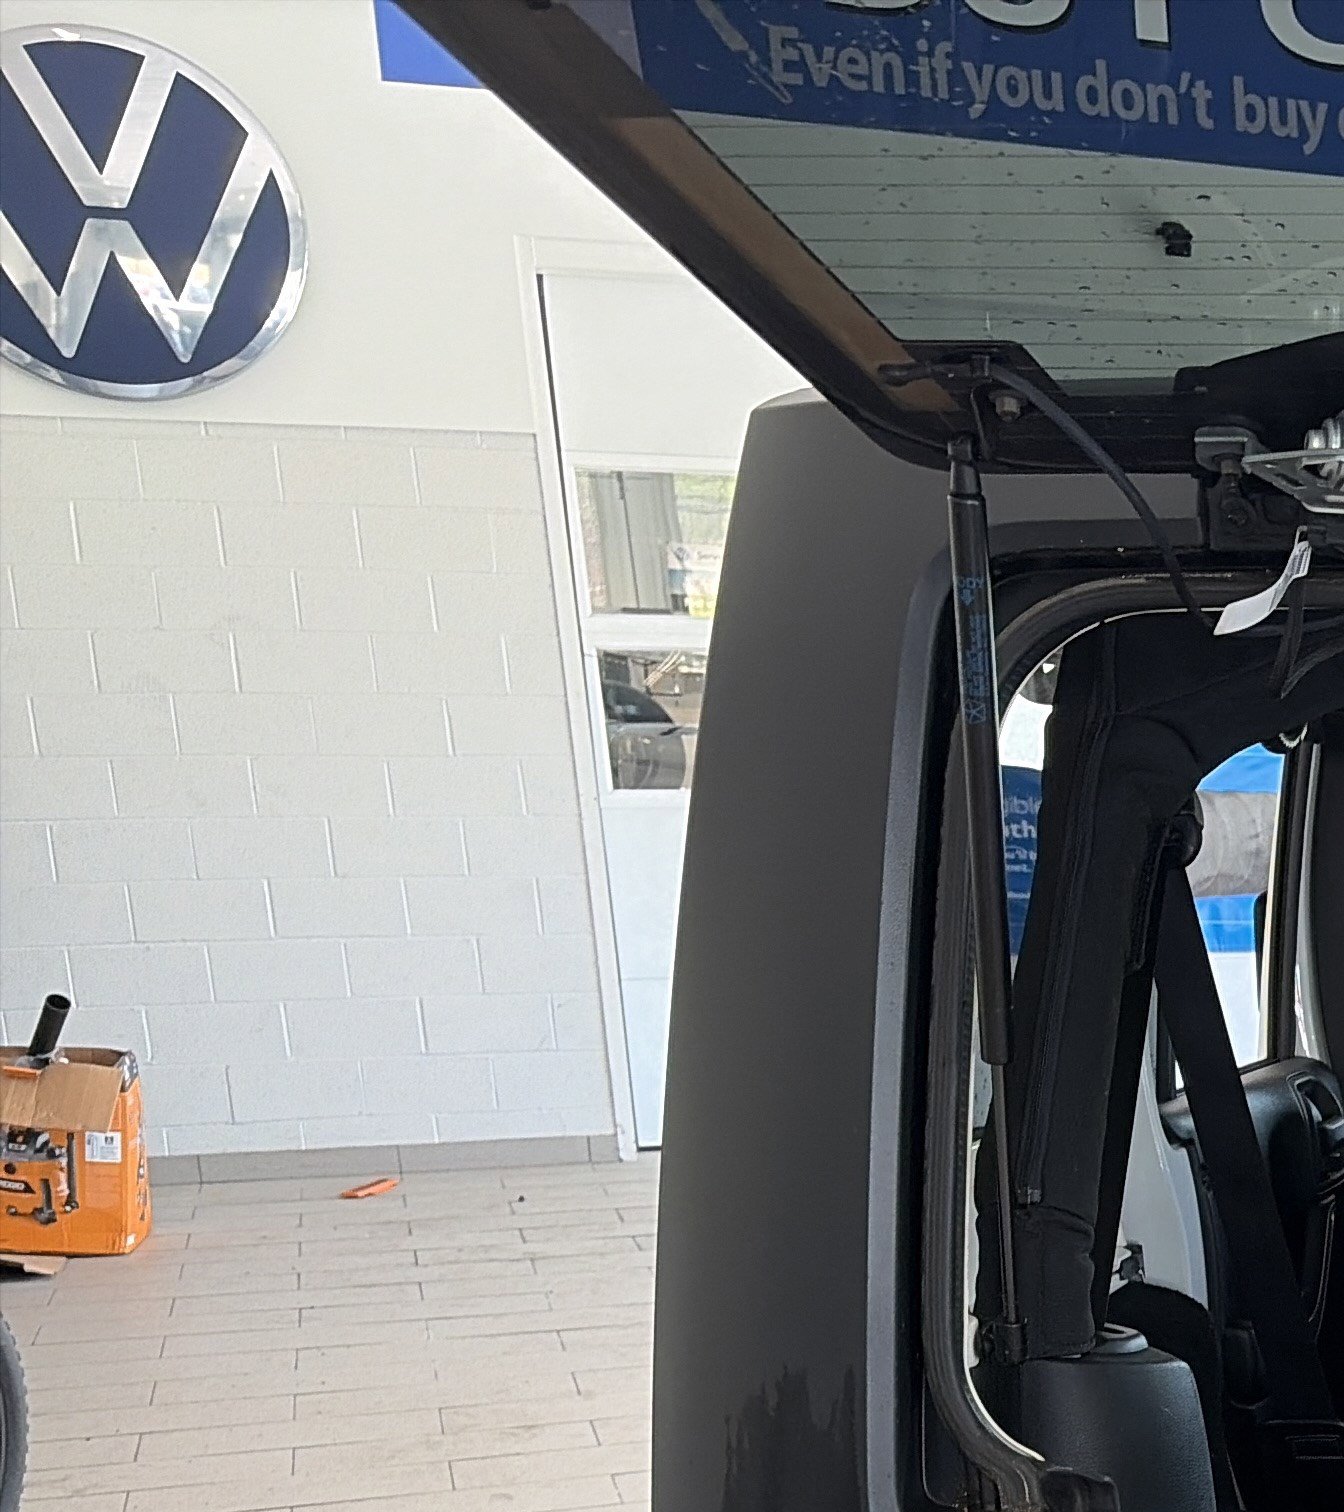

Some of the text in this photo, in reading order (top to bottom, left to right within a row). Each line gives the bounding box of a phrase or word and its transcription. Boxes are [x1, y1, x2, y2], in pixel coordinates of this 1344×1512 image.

[768, 23, 905, 94] Even
[918, 38, 954, 101] if
[961, 61, 1064, 118] you
[1075, 59, 1214, 130] don't
[1232, 76, 1326, 155] buy
